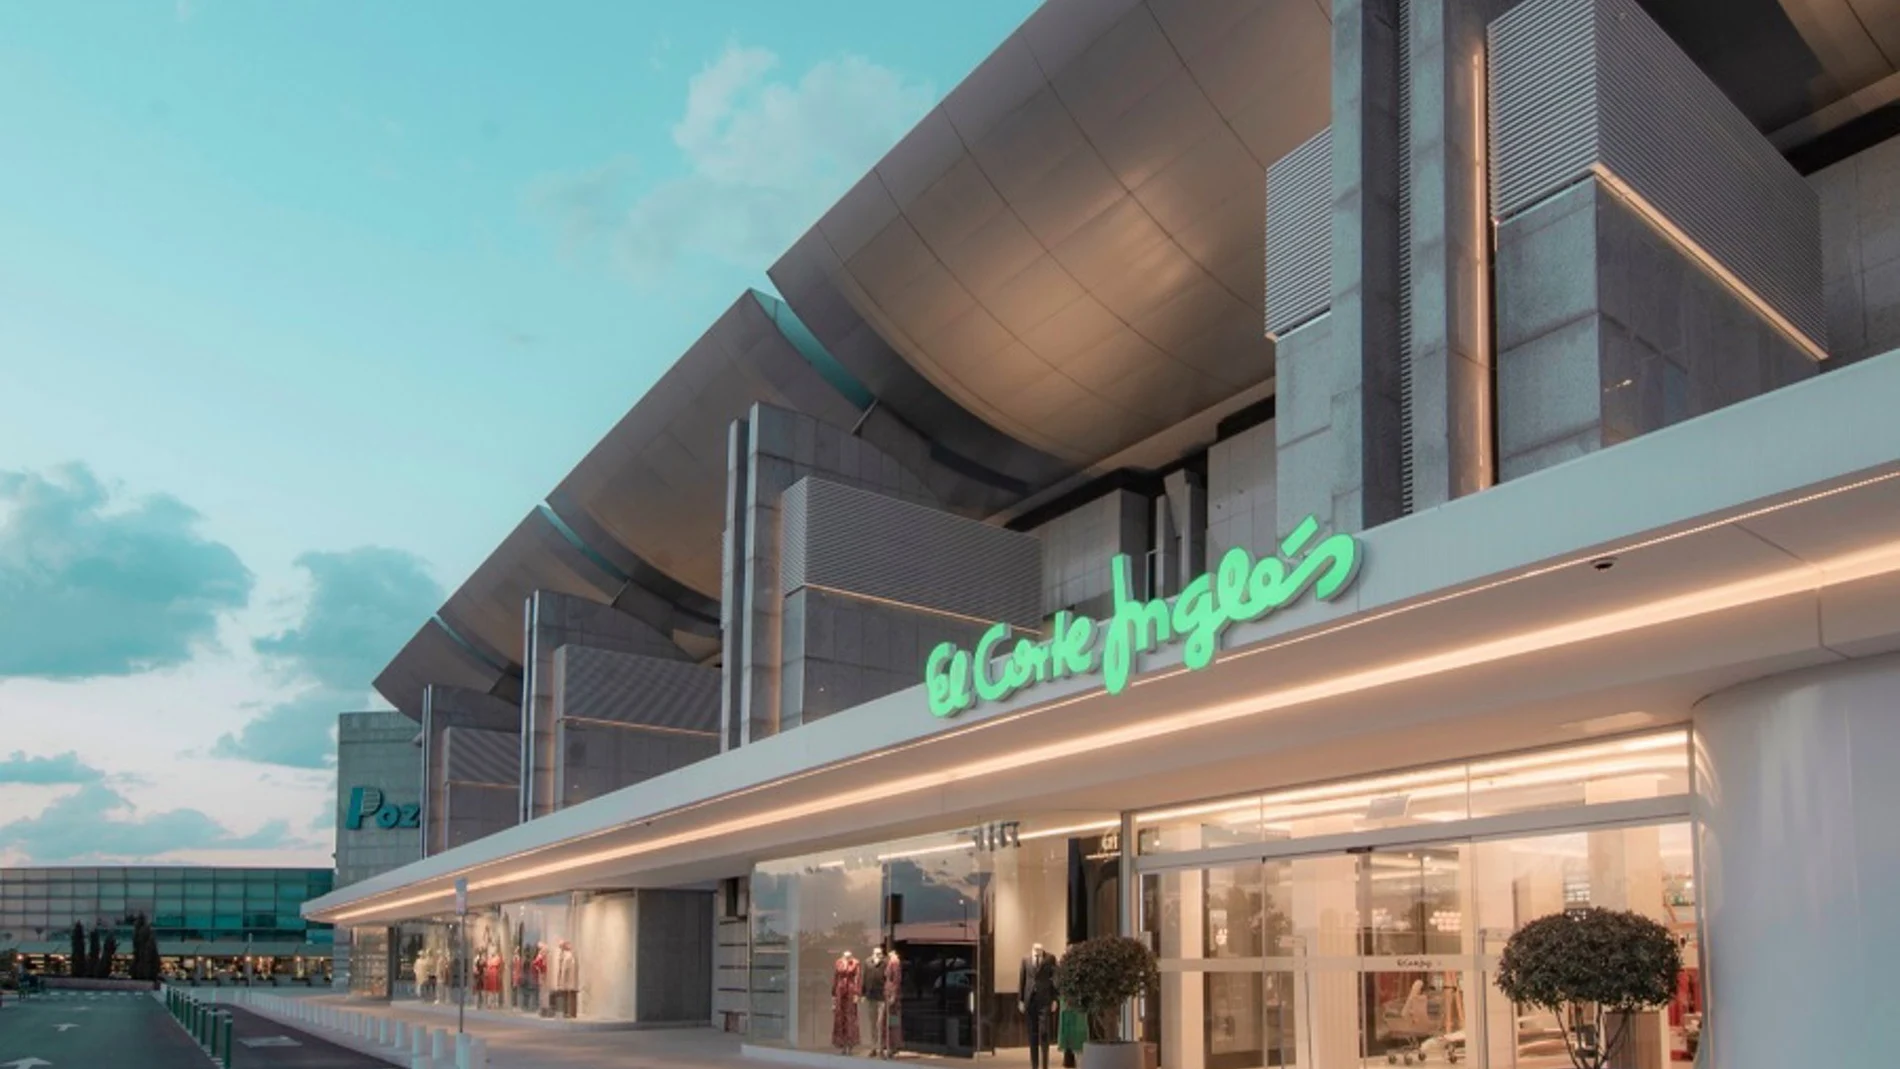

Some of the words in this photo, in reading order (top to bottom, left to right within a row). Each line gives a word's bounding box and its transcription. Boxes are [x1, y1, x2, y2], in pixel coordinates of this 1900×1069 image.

[925, 641, 973, 717] El
[973, 611, 1095, 701] Corte
[1102, 514, 1360, 695] Inglés
